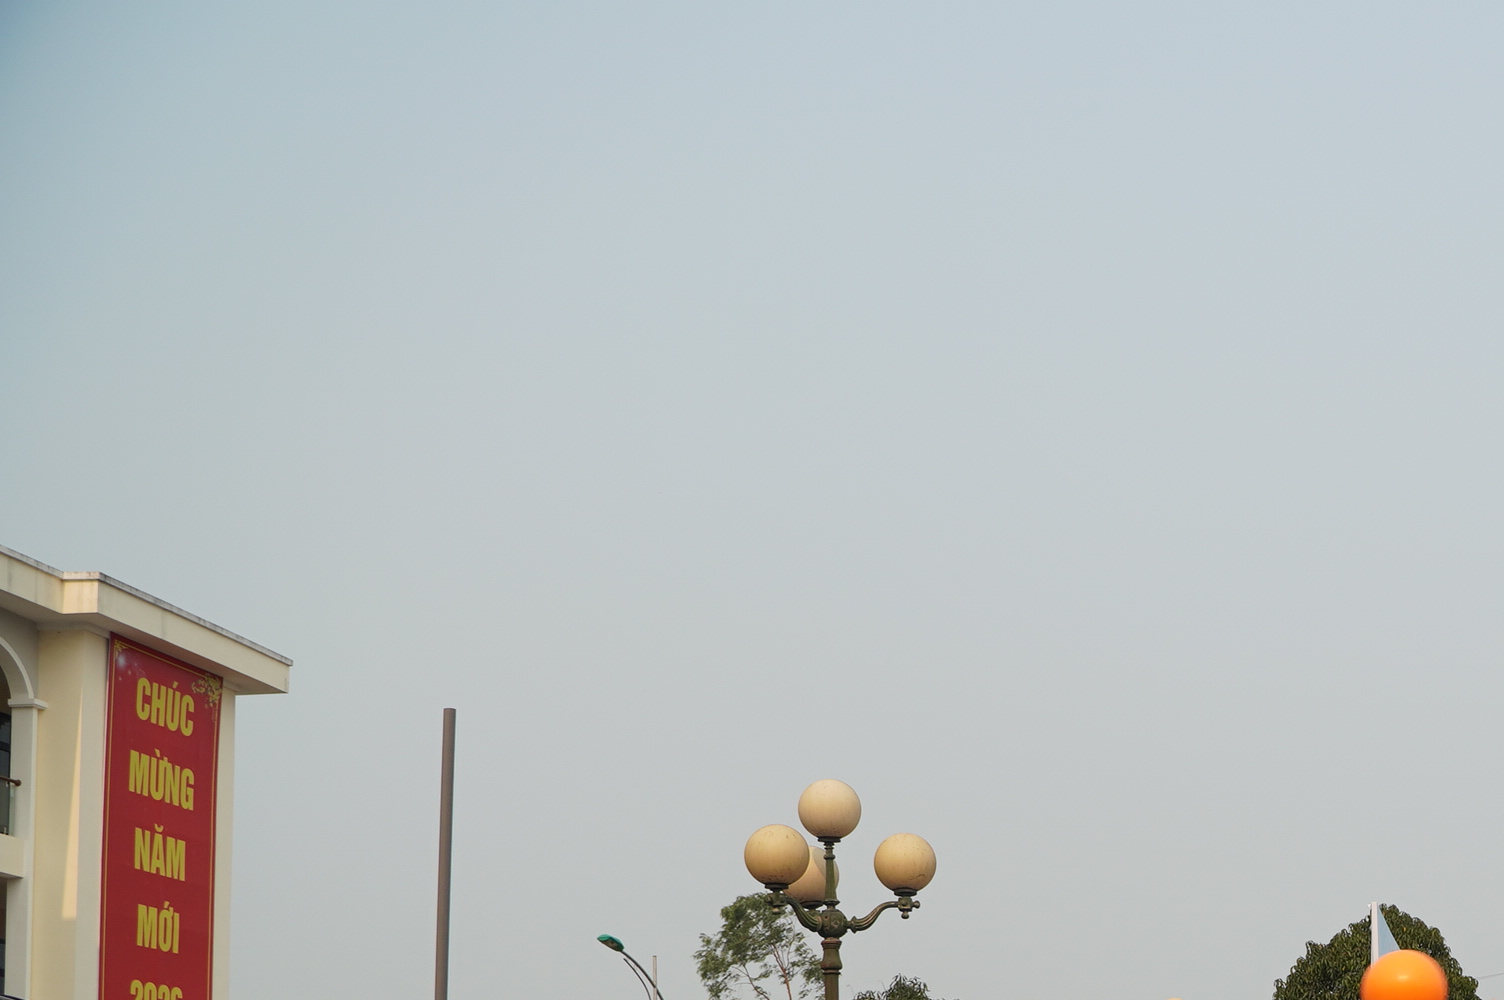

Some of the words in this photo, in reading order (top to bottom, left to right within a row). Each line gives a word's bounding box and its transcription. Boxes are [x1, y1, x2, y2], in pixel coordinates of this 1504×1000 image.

[136, 677, 195, 737] CHÚC
[129, 749, 195, 811] MỪNG
[134, 824, 186, 882] NĂM
[136, 901, 180, 954] MỚI
